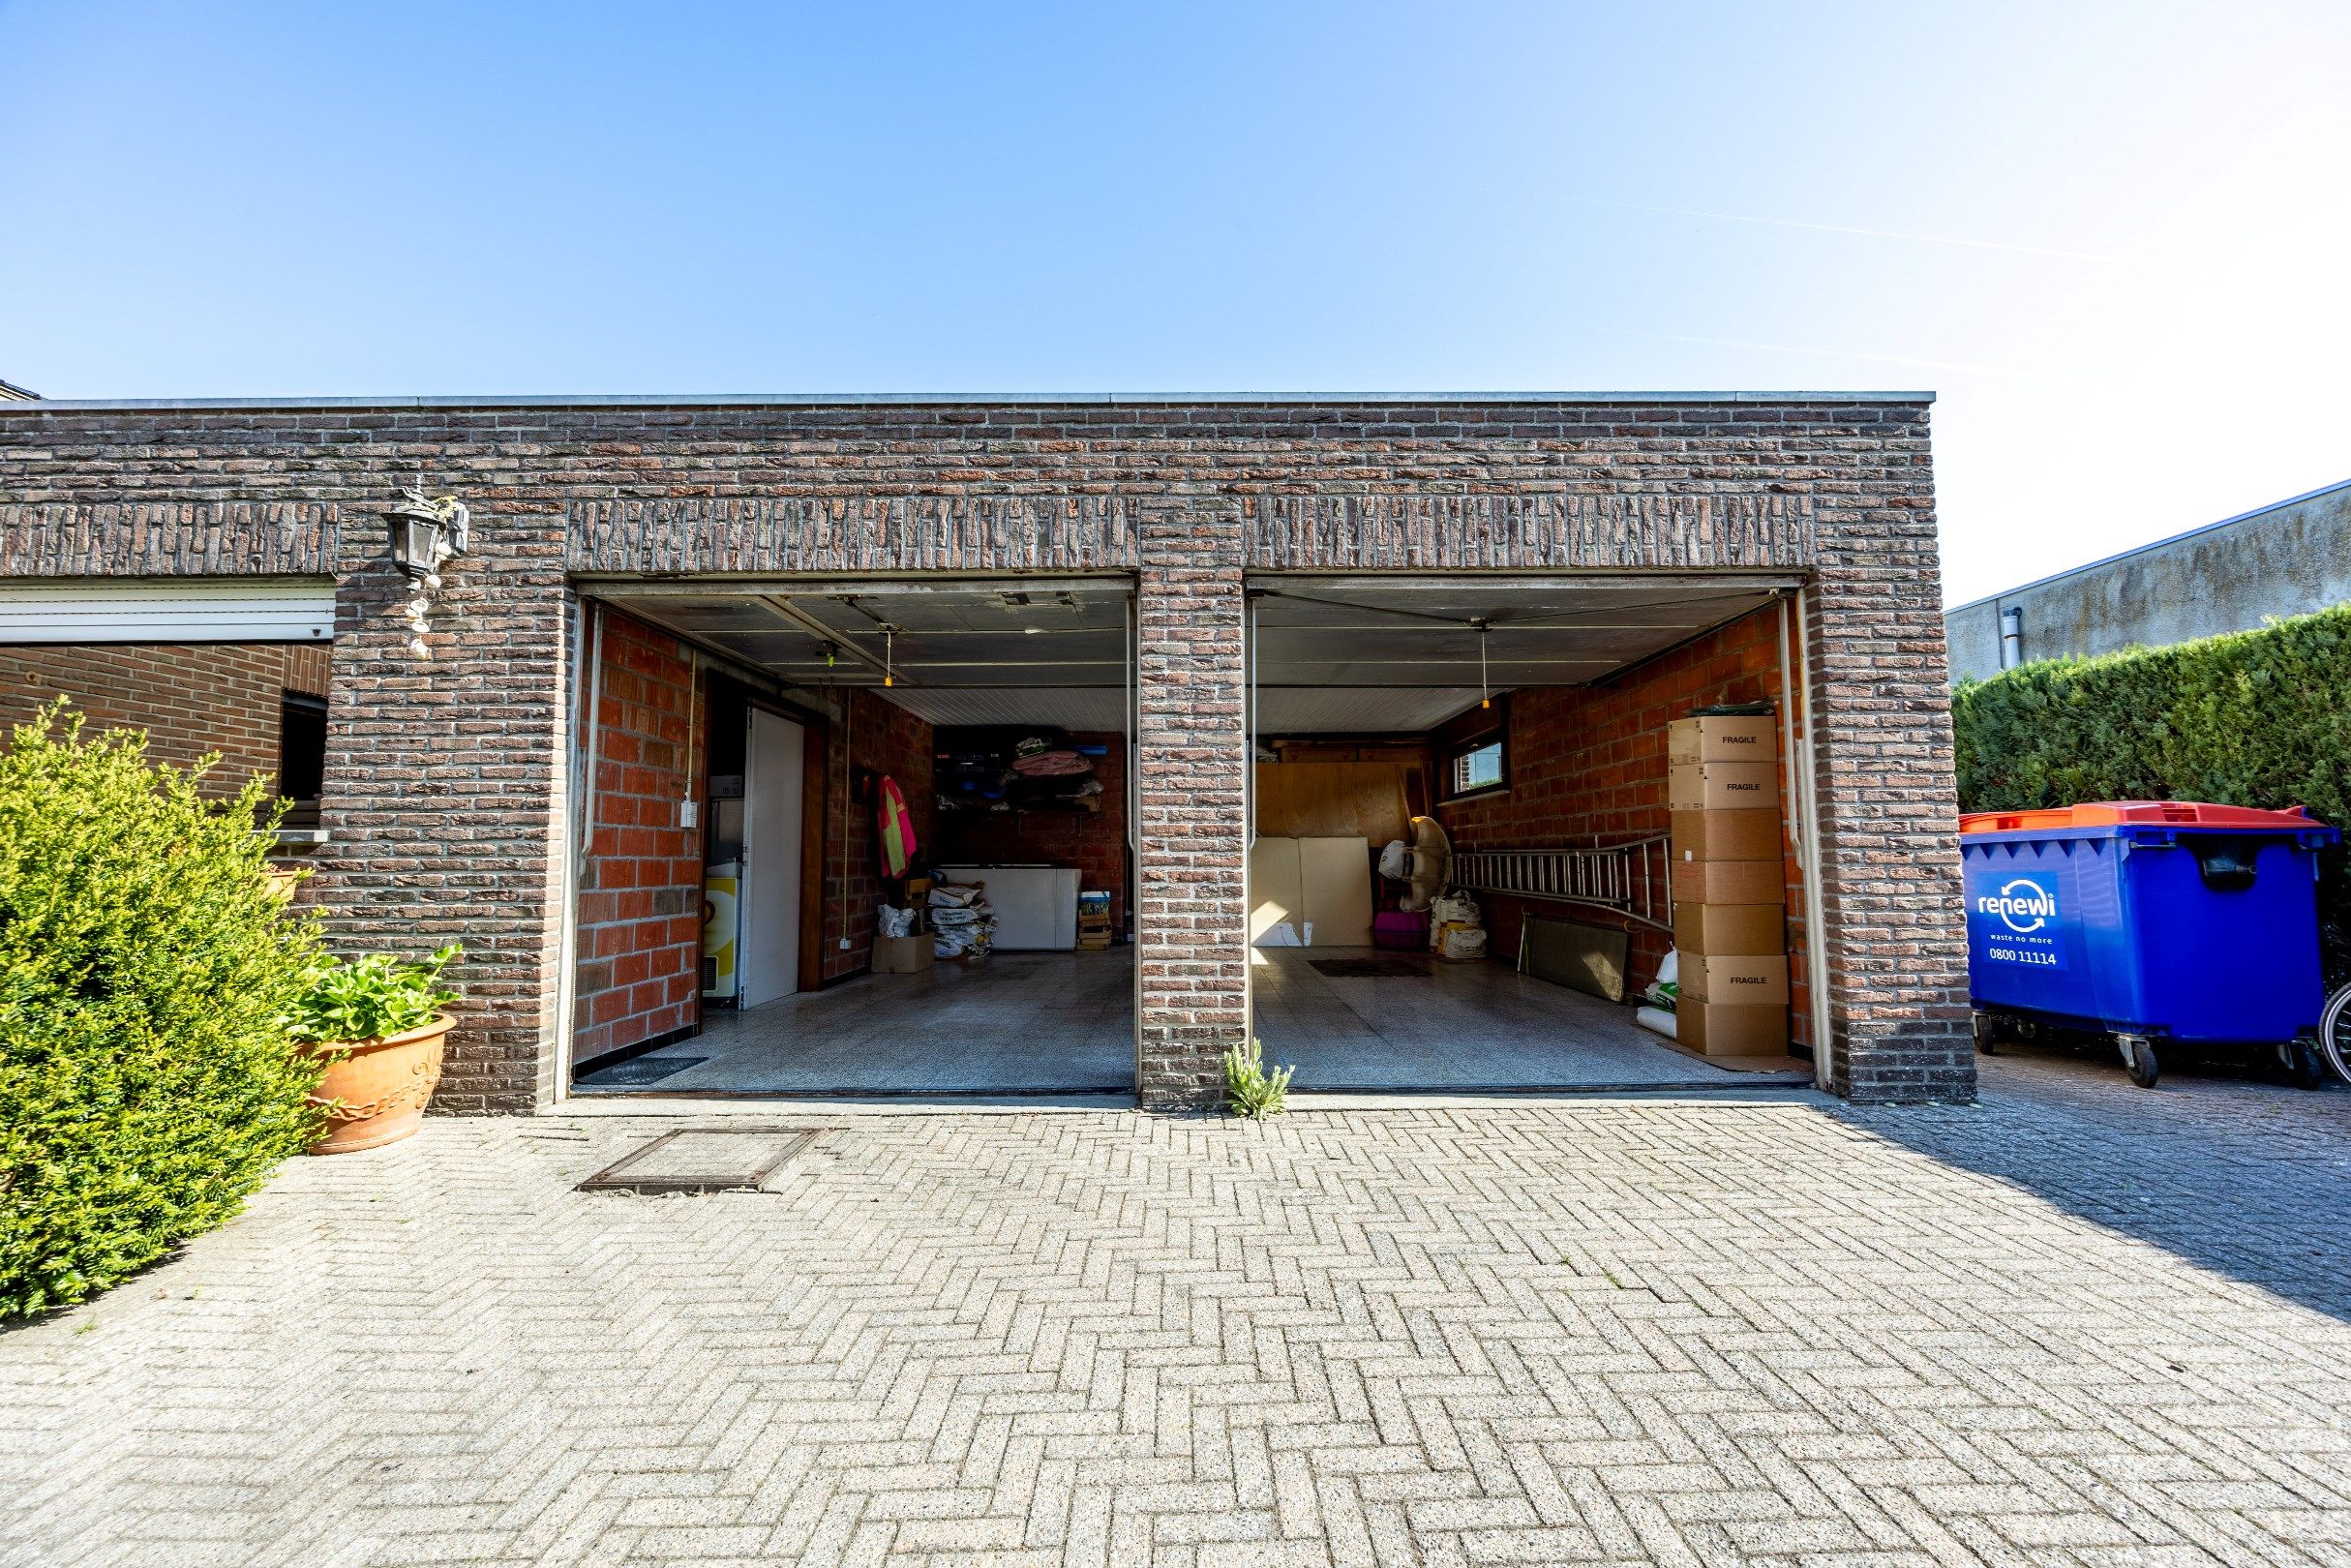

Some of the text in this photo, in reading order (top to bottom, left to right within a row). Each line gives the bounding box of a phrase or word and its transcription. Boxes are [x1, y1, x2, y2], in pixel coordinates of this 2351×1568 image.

[1977, 893, 2056, 917] renewi
[1989, 948, 2057, 965] 0800 11114
